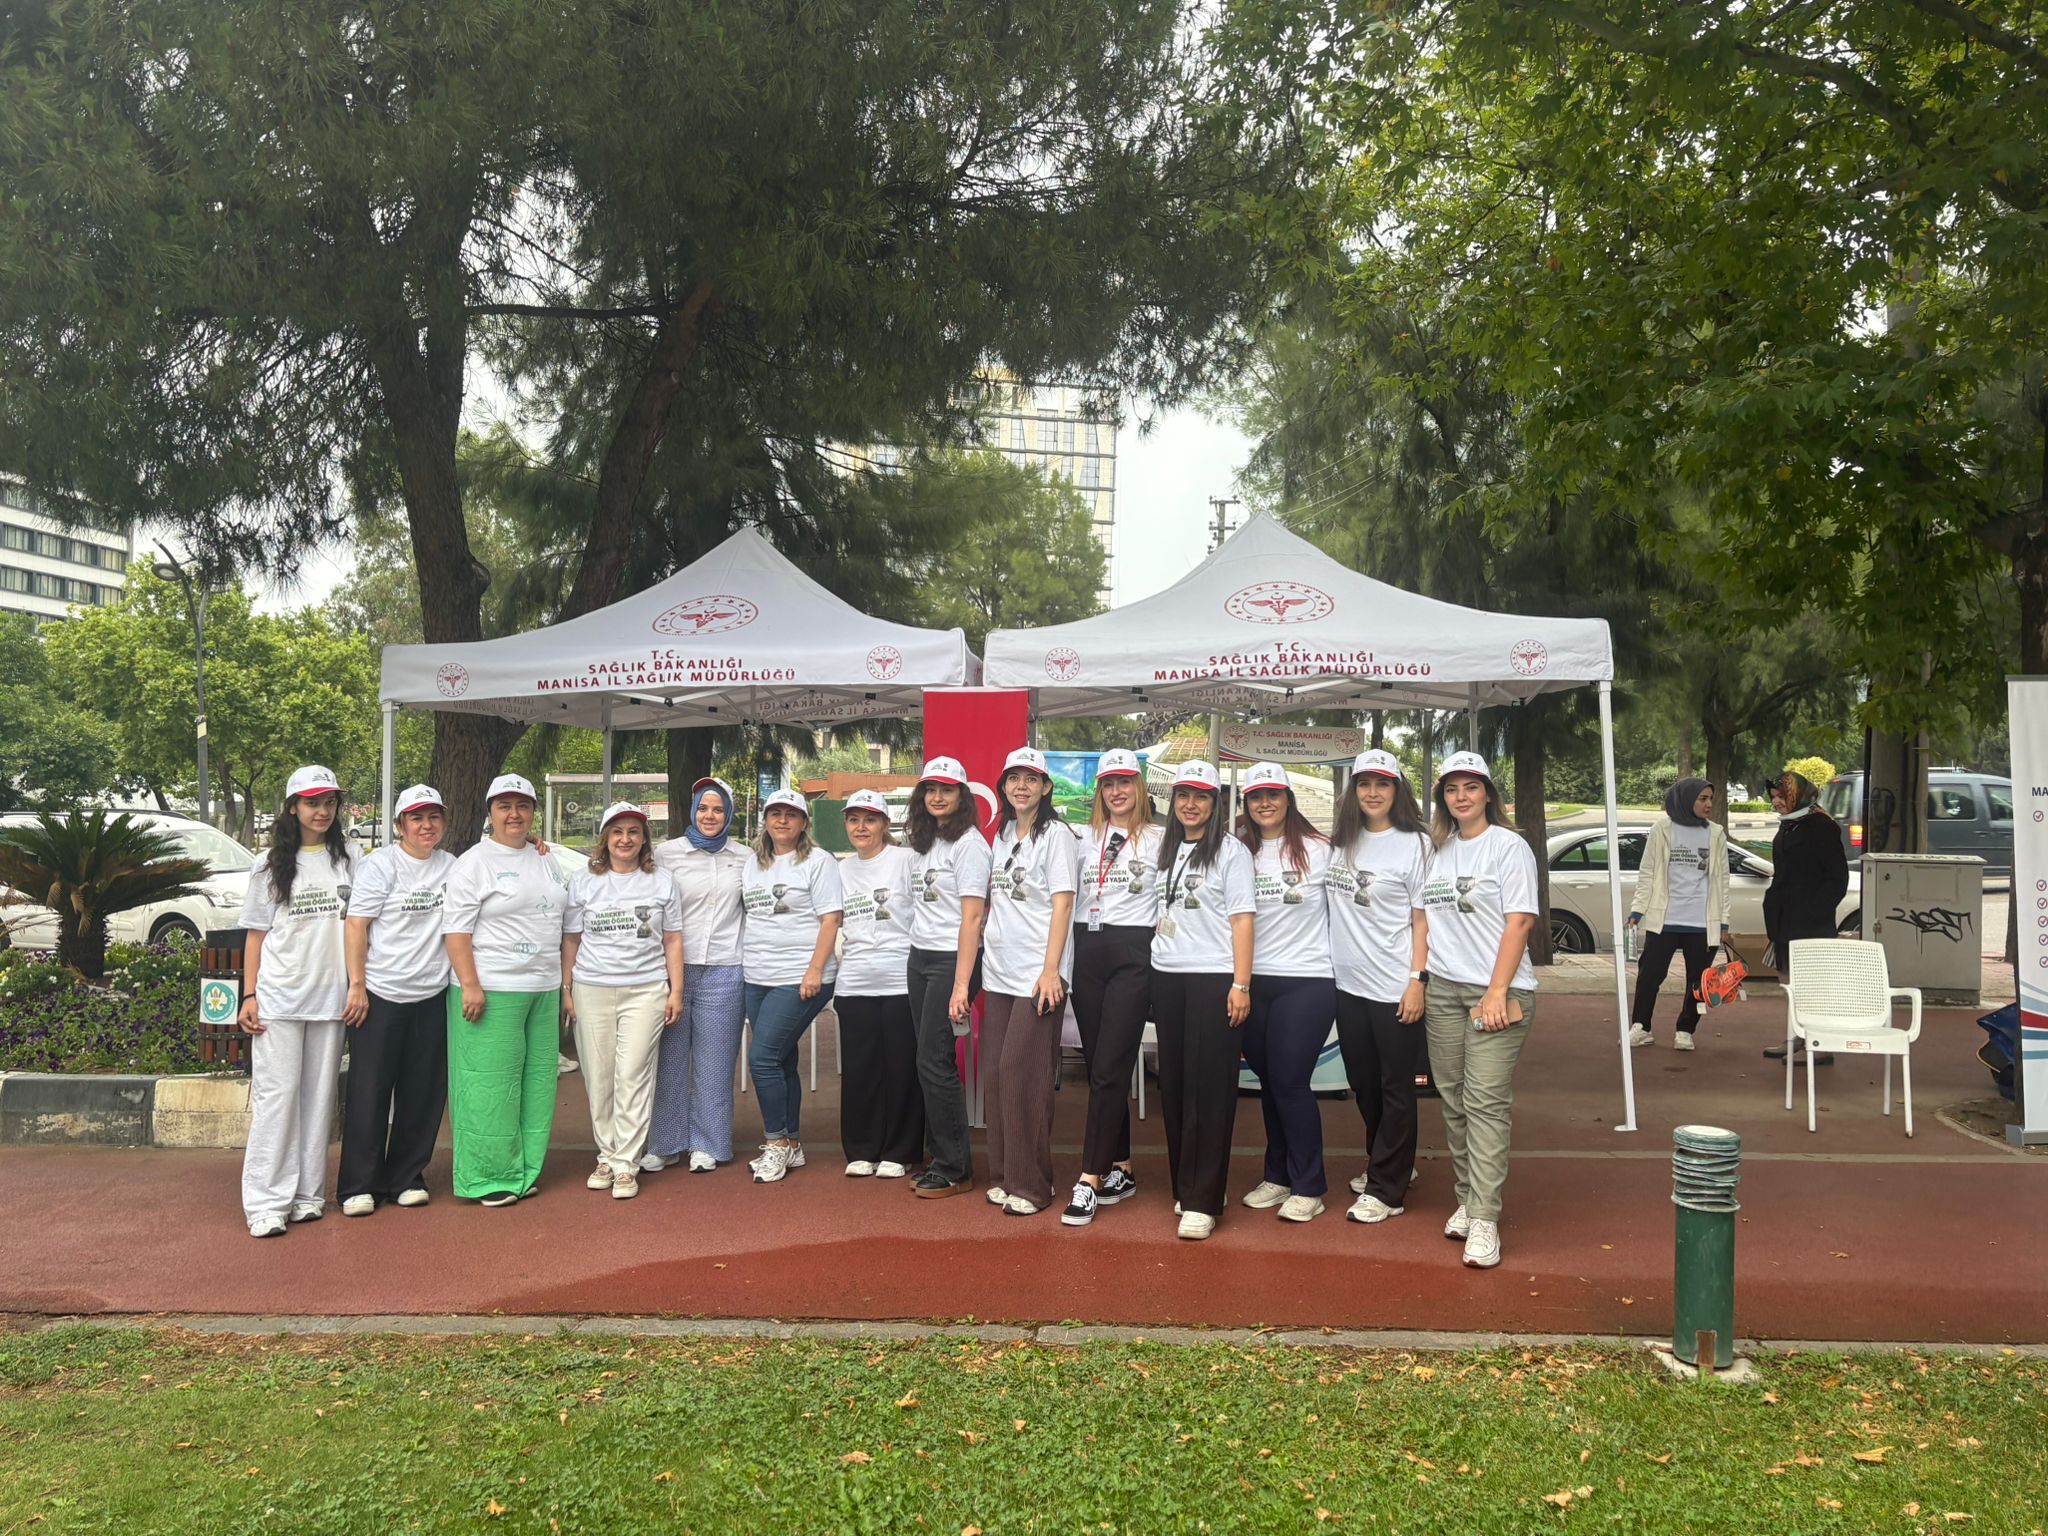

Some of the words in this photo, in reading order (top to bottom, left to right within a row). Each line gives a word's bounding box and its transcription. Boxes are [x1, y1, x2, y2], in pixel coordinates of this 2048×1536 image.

[1274, 642, 1306, 653] T.C.
[651, 649, 680, 661] T.C.
[1209, 652, 1270, 667] SAĞLIK
[1278, 650, 1374, 664] BAKANLIĞI
[588, 660, 646, 675] SAĞLIK
[654, 656, 743, 671] BAKANLIĞI
[1154, 667, 1221, 682] MANİSA
[1229, 665, 1244, 678] İL
[1249, 662, 1311, 677] SAĞLIK
[1318, 661, 1432, 677] MÜDÜRLÜĞÜ
[537, 676, 600, 691] MANİSA
[607, 673, 622, 686] İL
[626, 671, 682, 685] SAĞLIK
[690, 668, 796, 683] MÜDÜRLÜĞÜ
[1277, 740, 1306, 749] MANİSA
[1263, 747, 1287, 755] SAĞLIK
[296, 890, 328, 900] HAREKET
[312, 896, 337, 906] ÖĞREN
[319, 904, 340, 913] YAŞA!
[596, 910, 626, 919] HAREKET
[611, 916, 635, 925] ÖĞREN
[617, 923, 637, 931] YAŞA!
